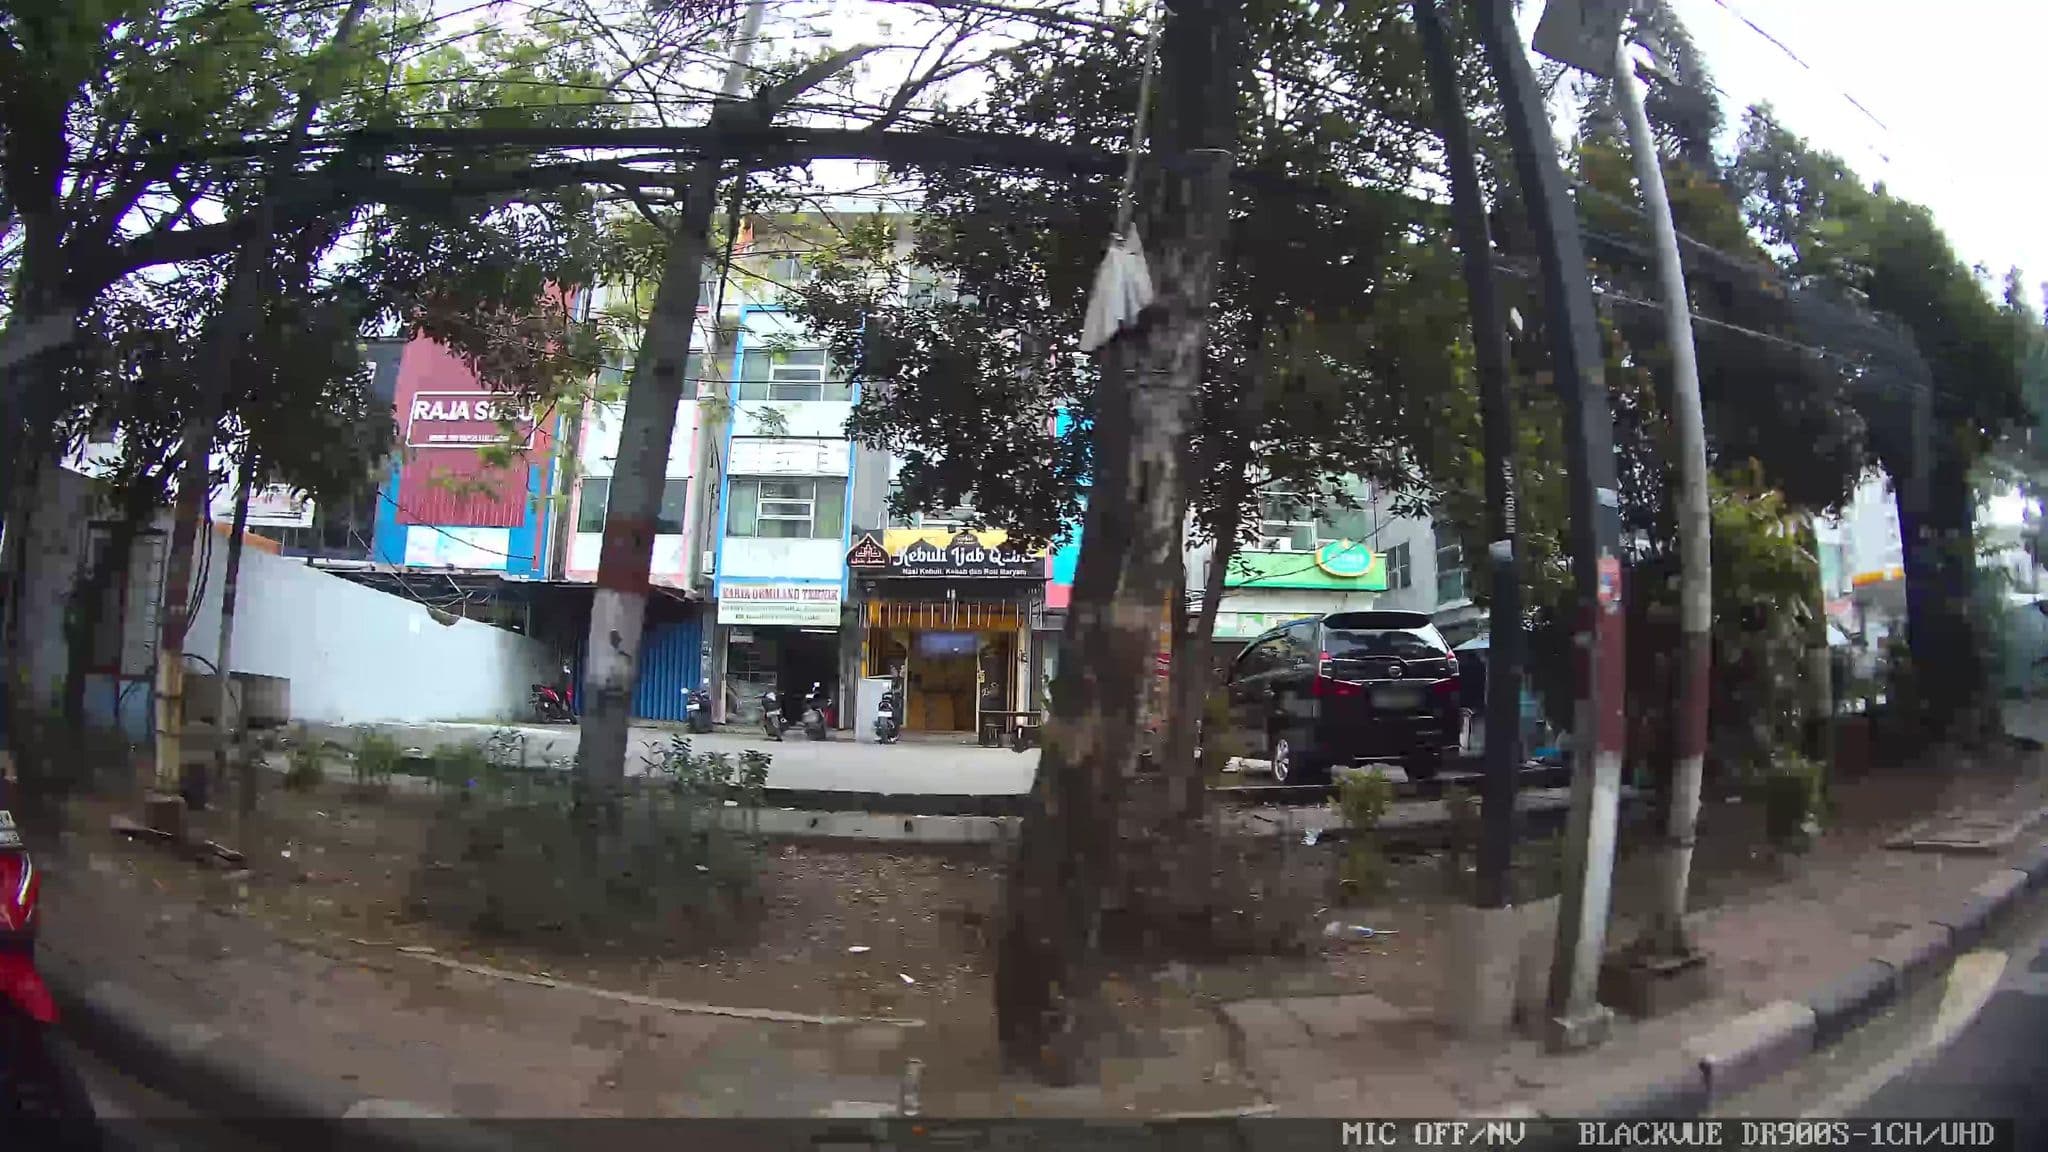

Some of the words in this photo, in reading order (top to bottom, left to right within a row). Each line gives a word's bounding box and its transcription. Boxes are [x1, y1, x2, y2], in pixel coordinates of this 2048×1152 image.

[414, 400, 470, 421] RAJA
[892, 545, 948, 567] Kebuli
[951, 546, 985, 567] Ijab
